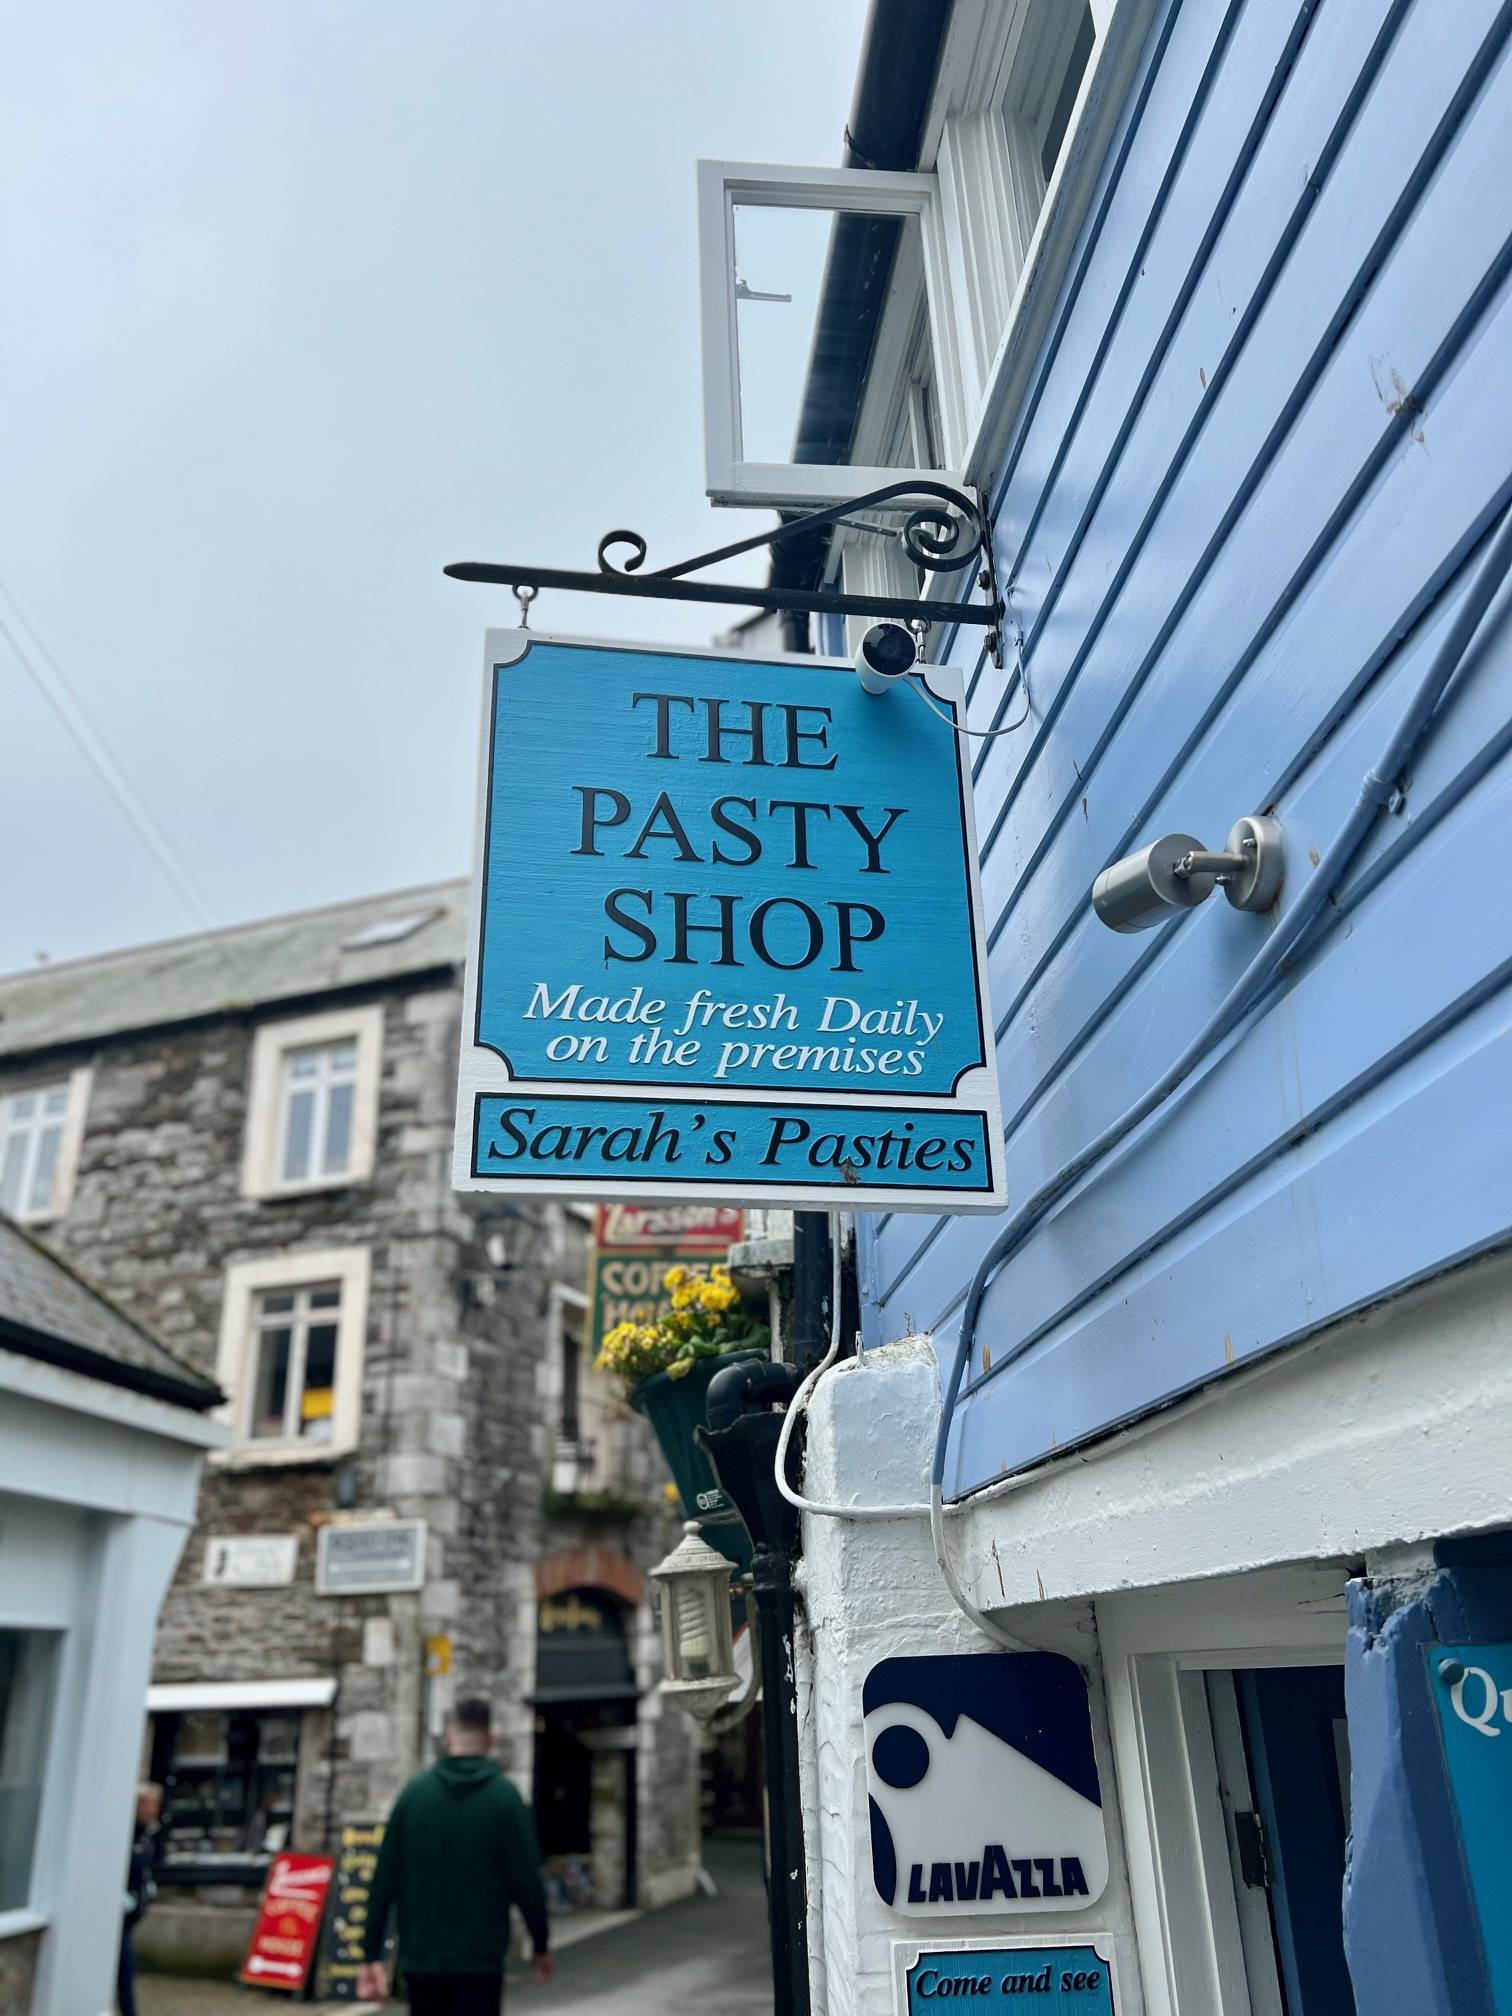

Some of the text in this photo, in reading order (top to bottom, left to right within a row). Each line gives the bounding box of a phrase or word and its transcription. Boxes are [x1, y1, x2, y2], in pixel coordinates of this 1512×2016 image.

[632, 691, 839, 770] THE
[569, 786, 909, 874] PASTY
[603, 888, 886, 972] SHOP
[523, 983, 943, 1046] Made fresh Daily
[546, 1028, 925, 1078] on the premises
[488, 1106, 975, 1172] Sarah's Pasties
[908, 1845, 1089, 1903] LAVAZZA
[916, 1964, 1100, 1998] Come and see
